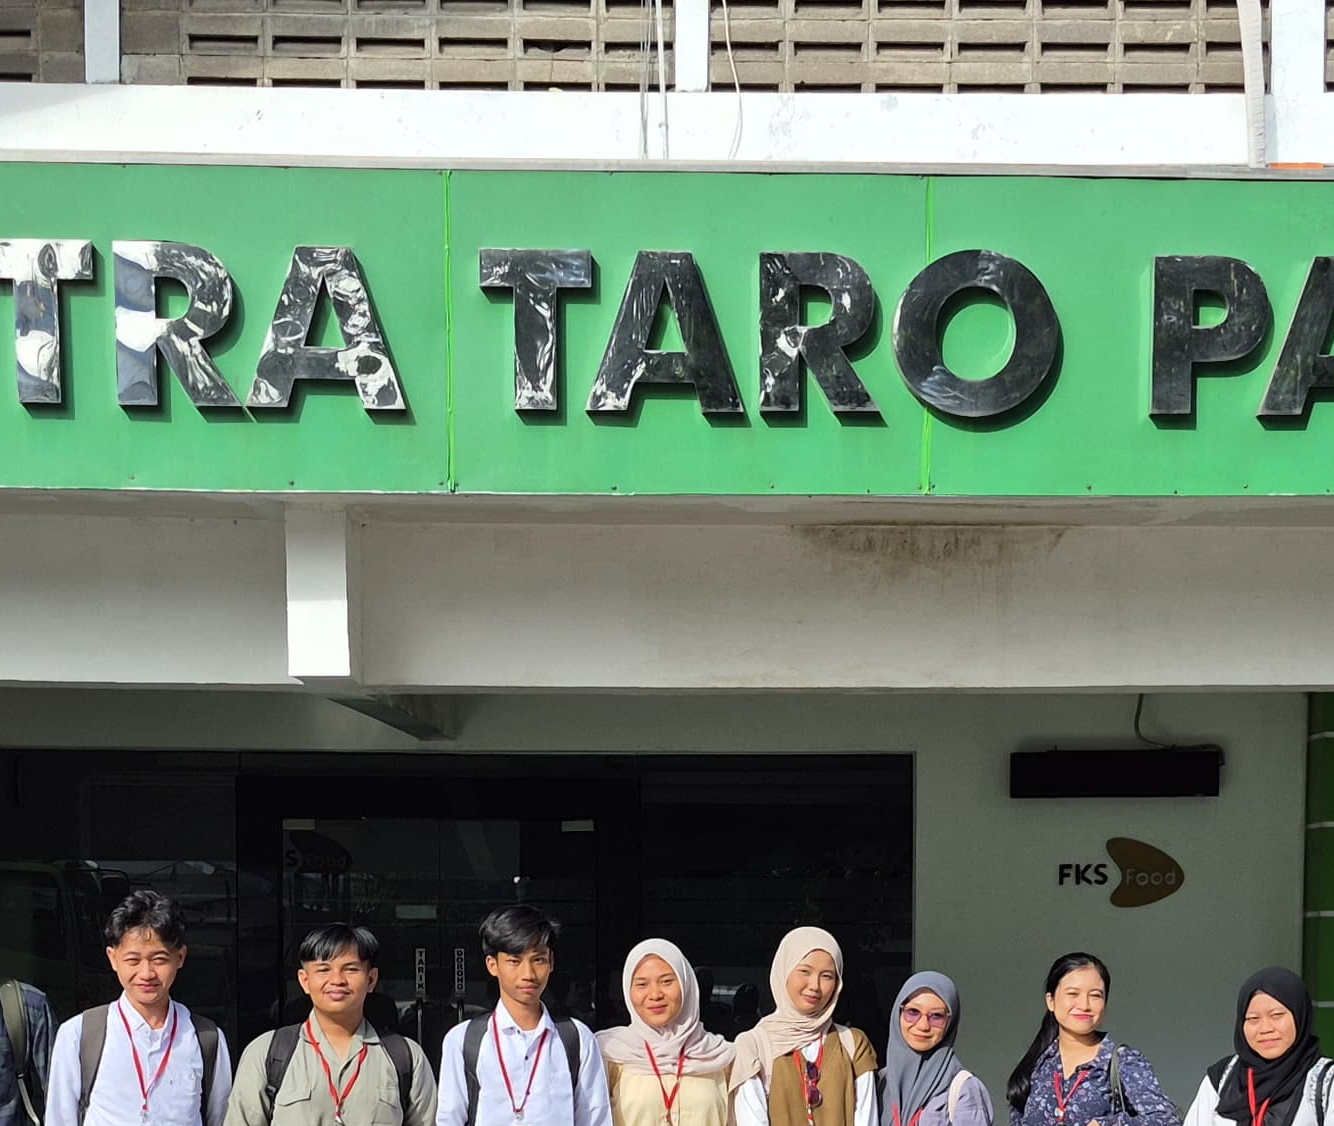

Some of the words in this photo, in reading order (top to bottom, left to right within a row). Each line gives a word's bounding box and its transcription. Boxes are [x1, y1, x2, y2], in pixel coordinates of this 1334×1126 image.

[478, 248, 1063, 421] TARO
[1059, 864, 1108, 885] FKS
[1125, 868, 1177, 887] Food
[417, 950, 425, 990] TARIK
